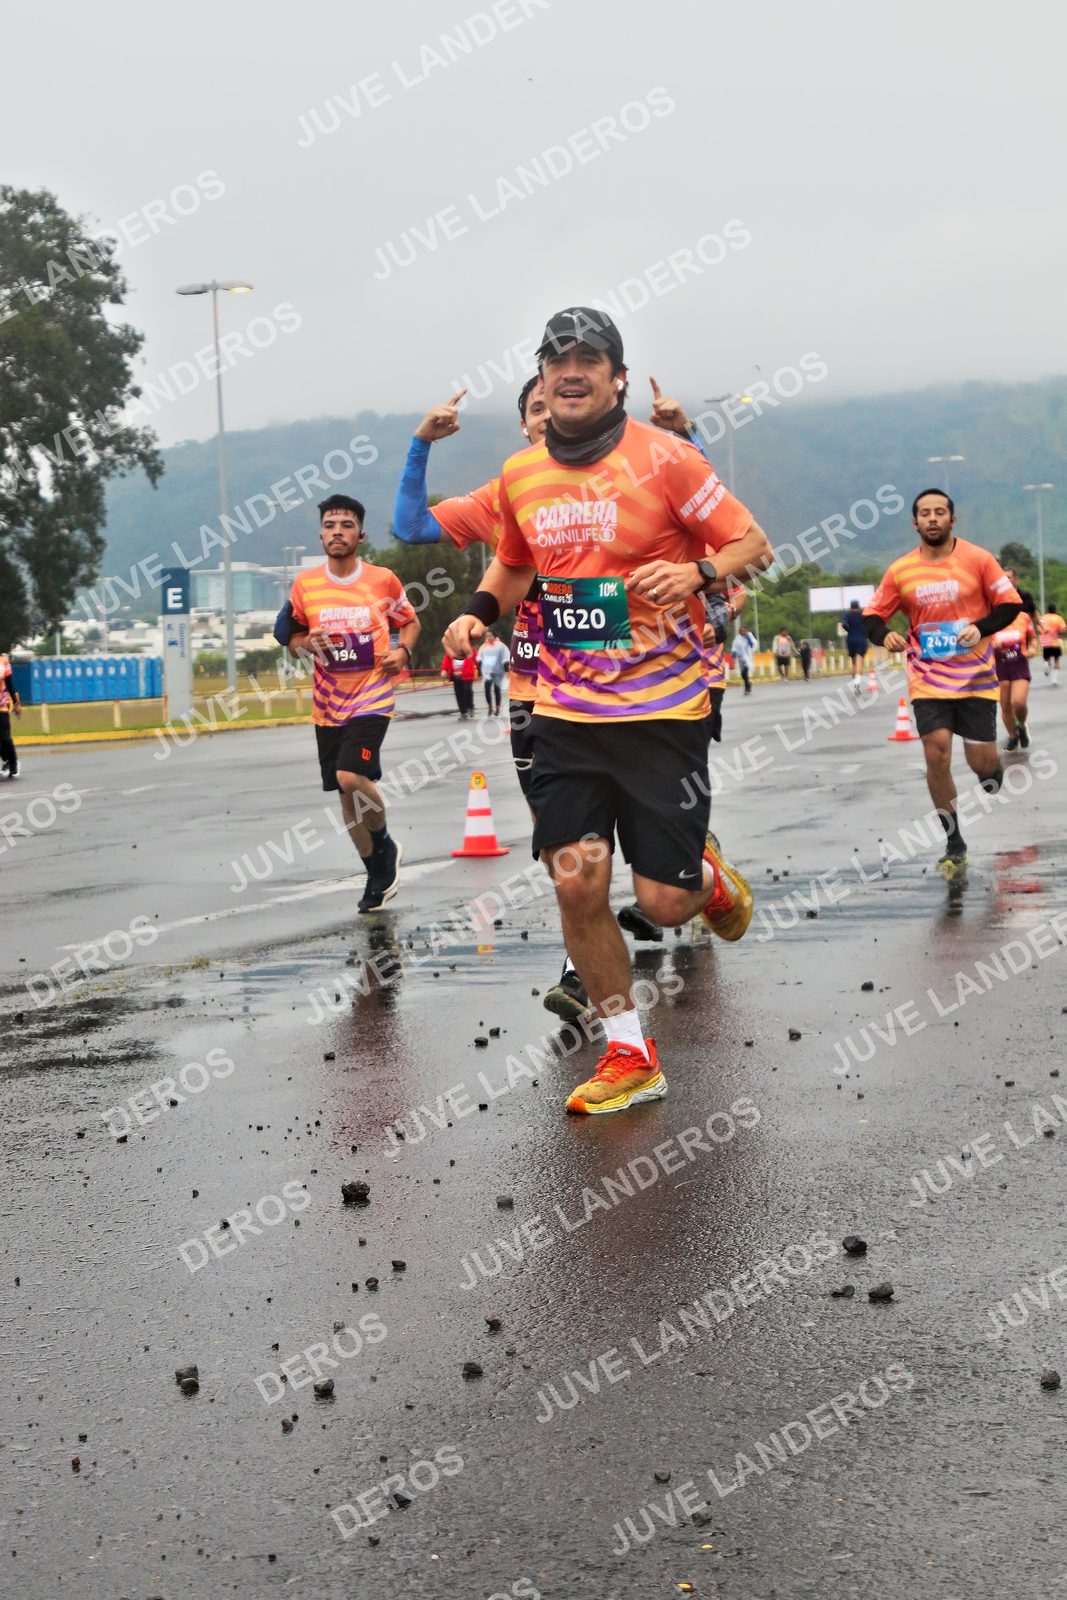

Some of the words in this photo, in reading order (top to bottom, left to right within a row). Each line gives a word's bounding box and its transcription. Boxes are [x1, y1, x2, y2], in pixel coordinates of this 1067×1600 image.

[536, 500, 617, 531] CARRERA
[167, 587, 184, 609] E
[319, 606, 370, 622] CARRERA
[553, 608, 606, 629] 1620
